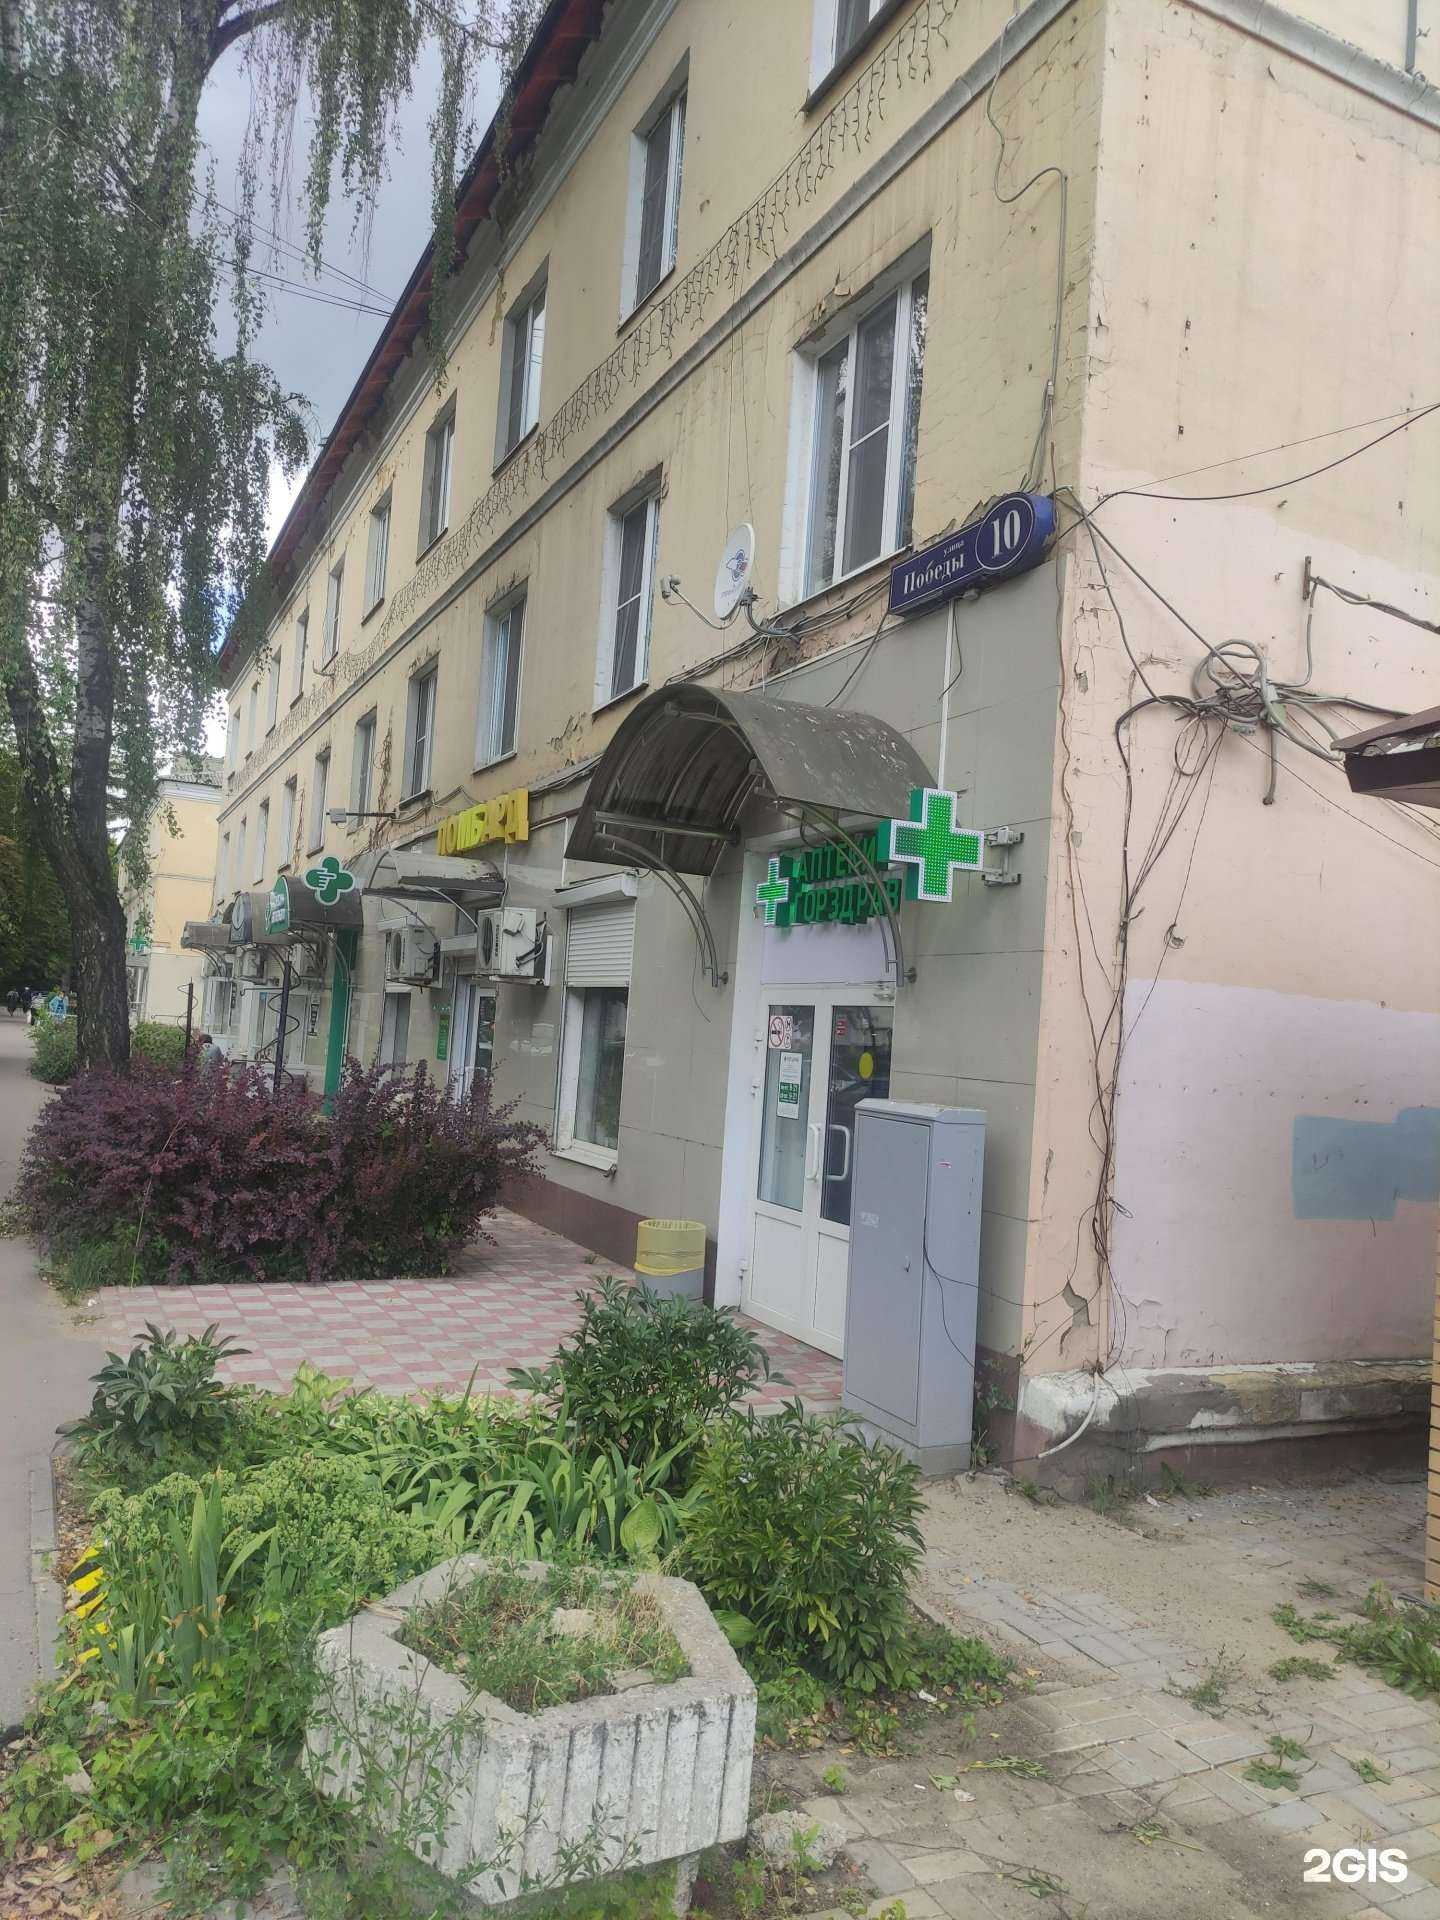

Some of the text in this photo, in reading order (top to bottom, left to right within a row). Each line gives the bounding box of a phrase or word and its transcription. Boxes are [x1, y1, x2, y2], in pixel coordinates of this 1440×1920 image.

[991, 509, 1021, 559] 10
[903, 554, 965, 595] Победы
[789, 879, 902, 926] ГОРЗДРАВ
